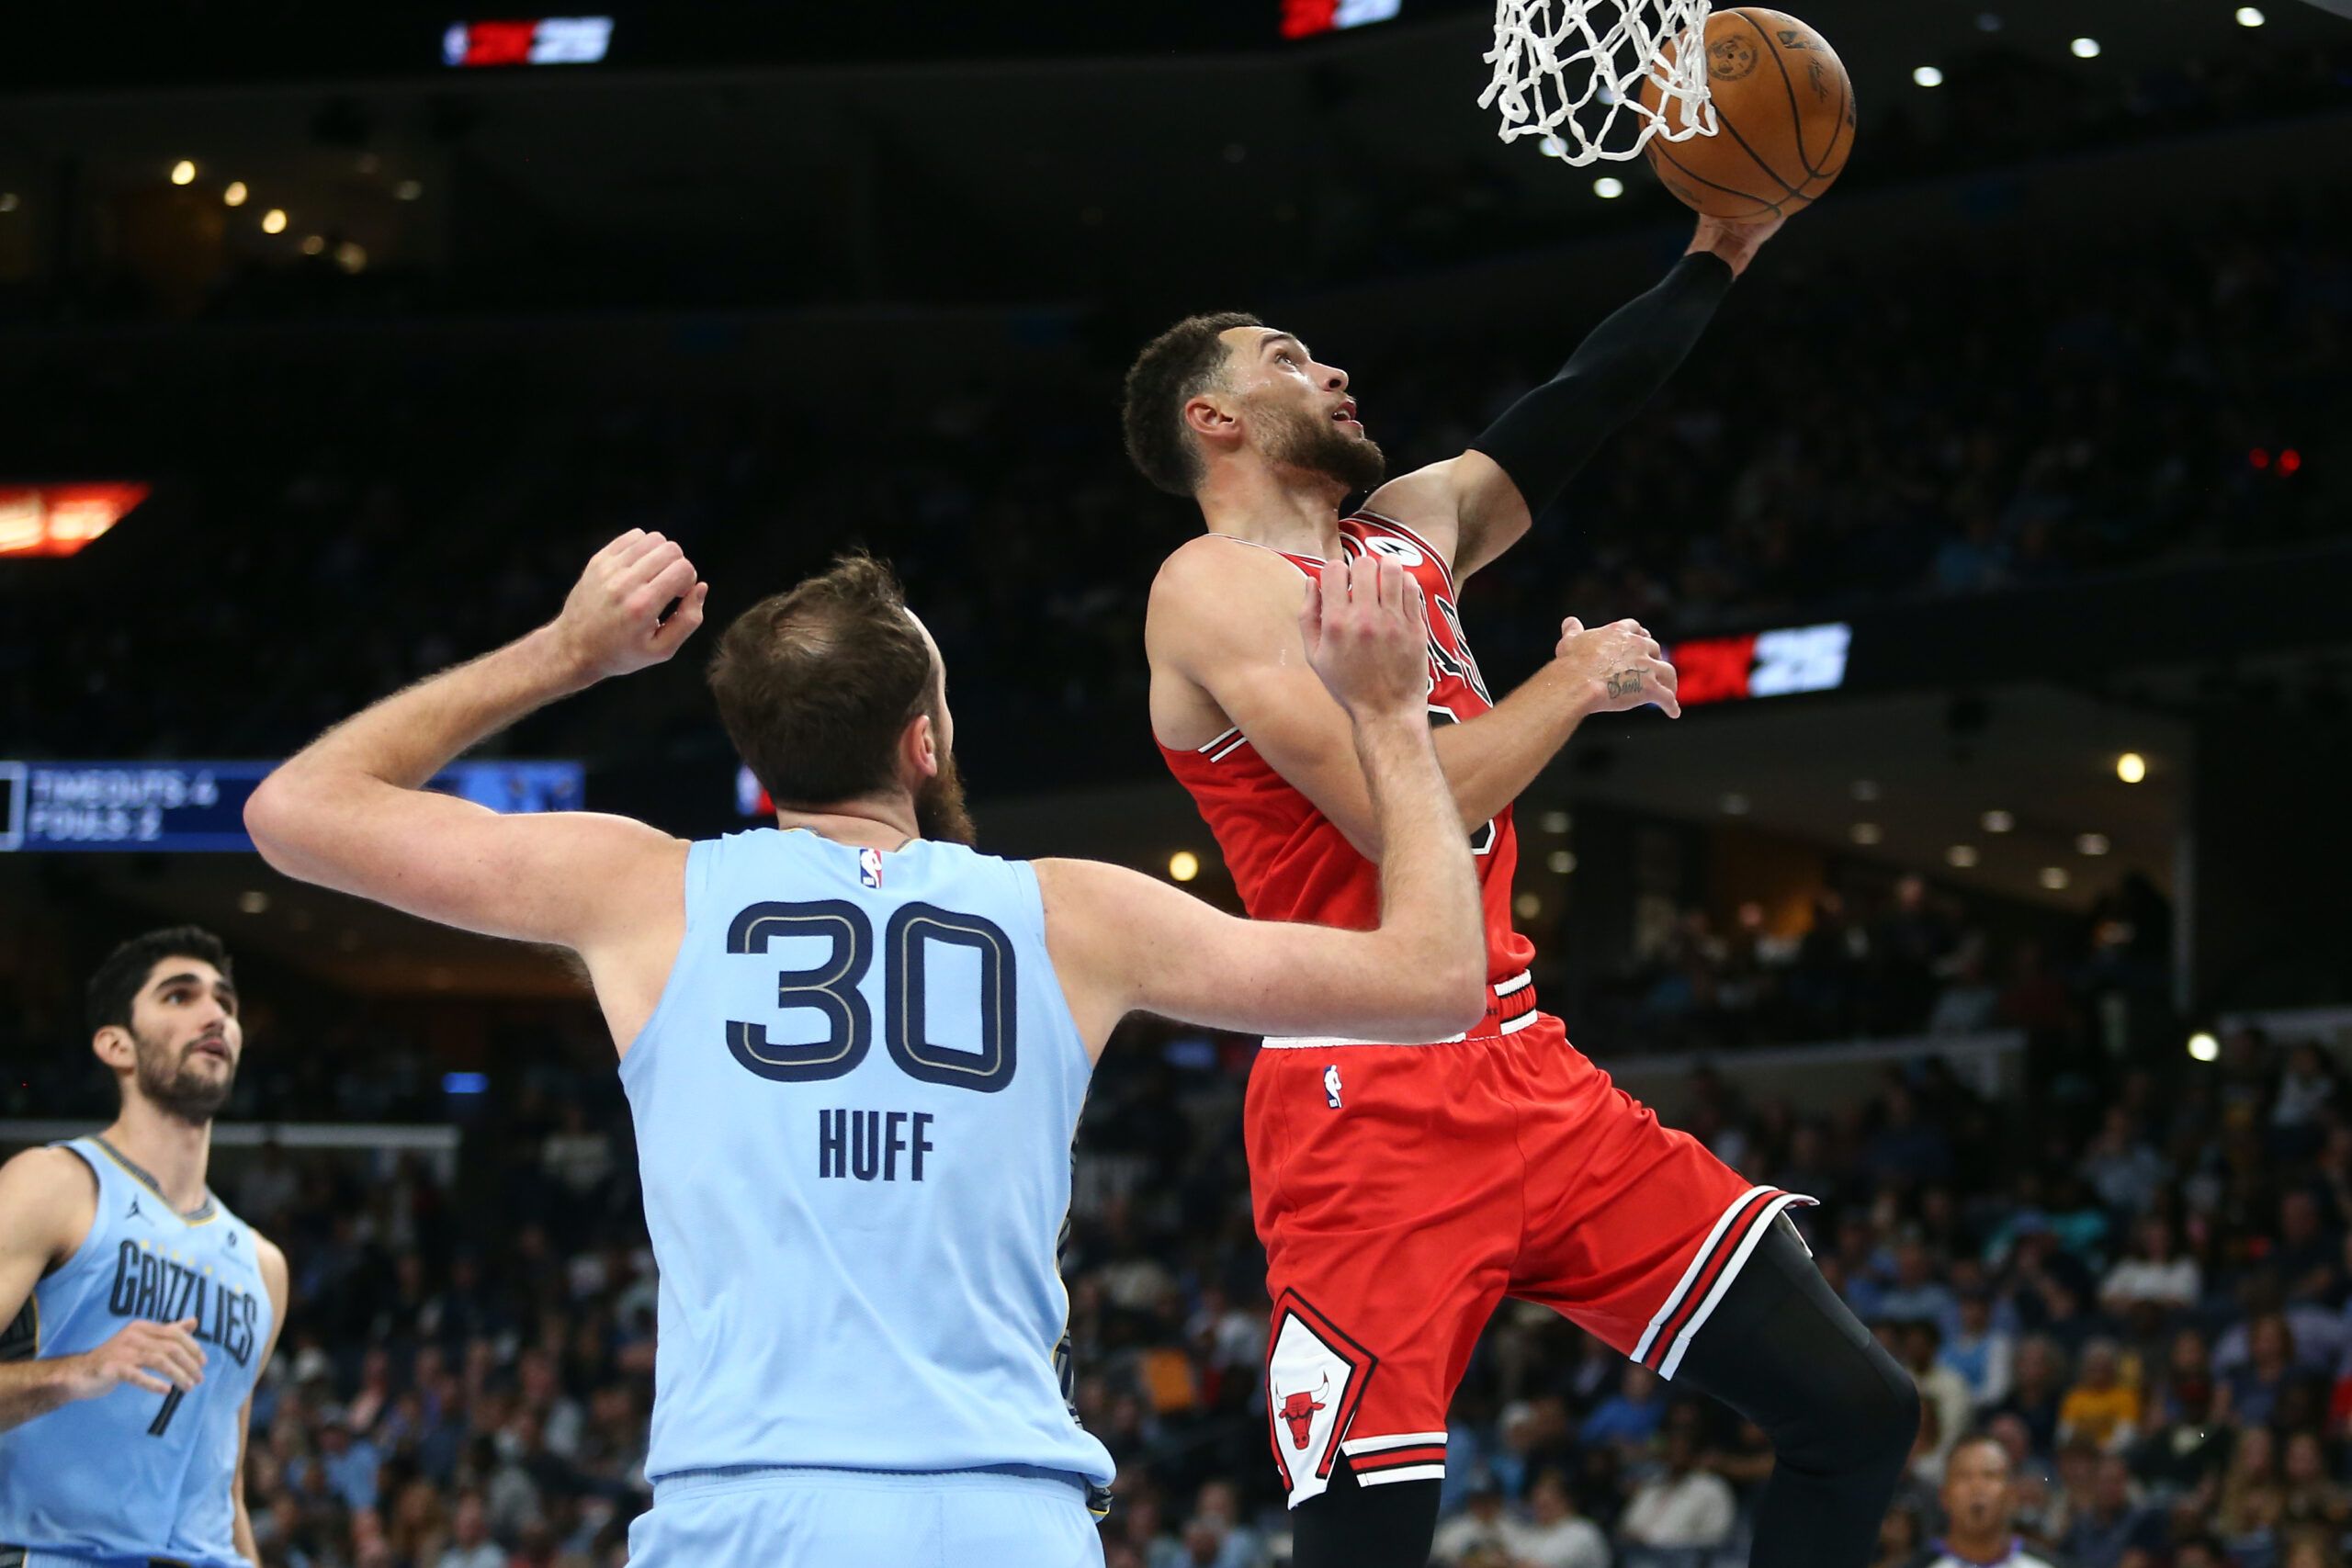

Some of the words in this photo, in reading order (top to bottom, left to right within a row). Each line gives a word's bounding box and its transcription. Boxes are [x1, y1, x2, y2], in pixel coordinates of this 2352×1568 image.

[726, 899, 1017, 1093] 30
[819, 1109, 933, 1181] HUFF
[109, 1239, 257, 1367] GRIZZLIES
